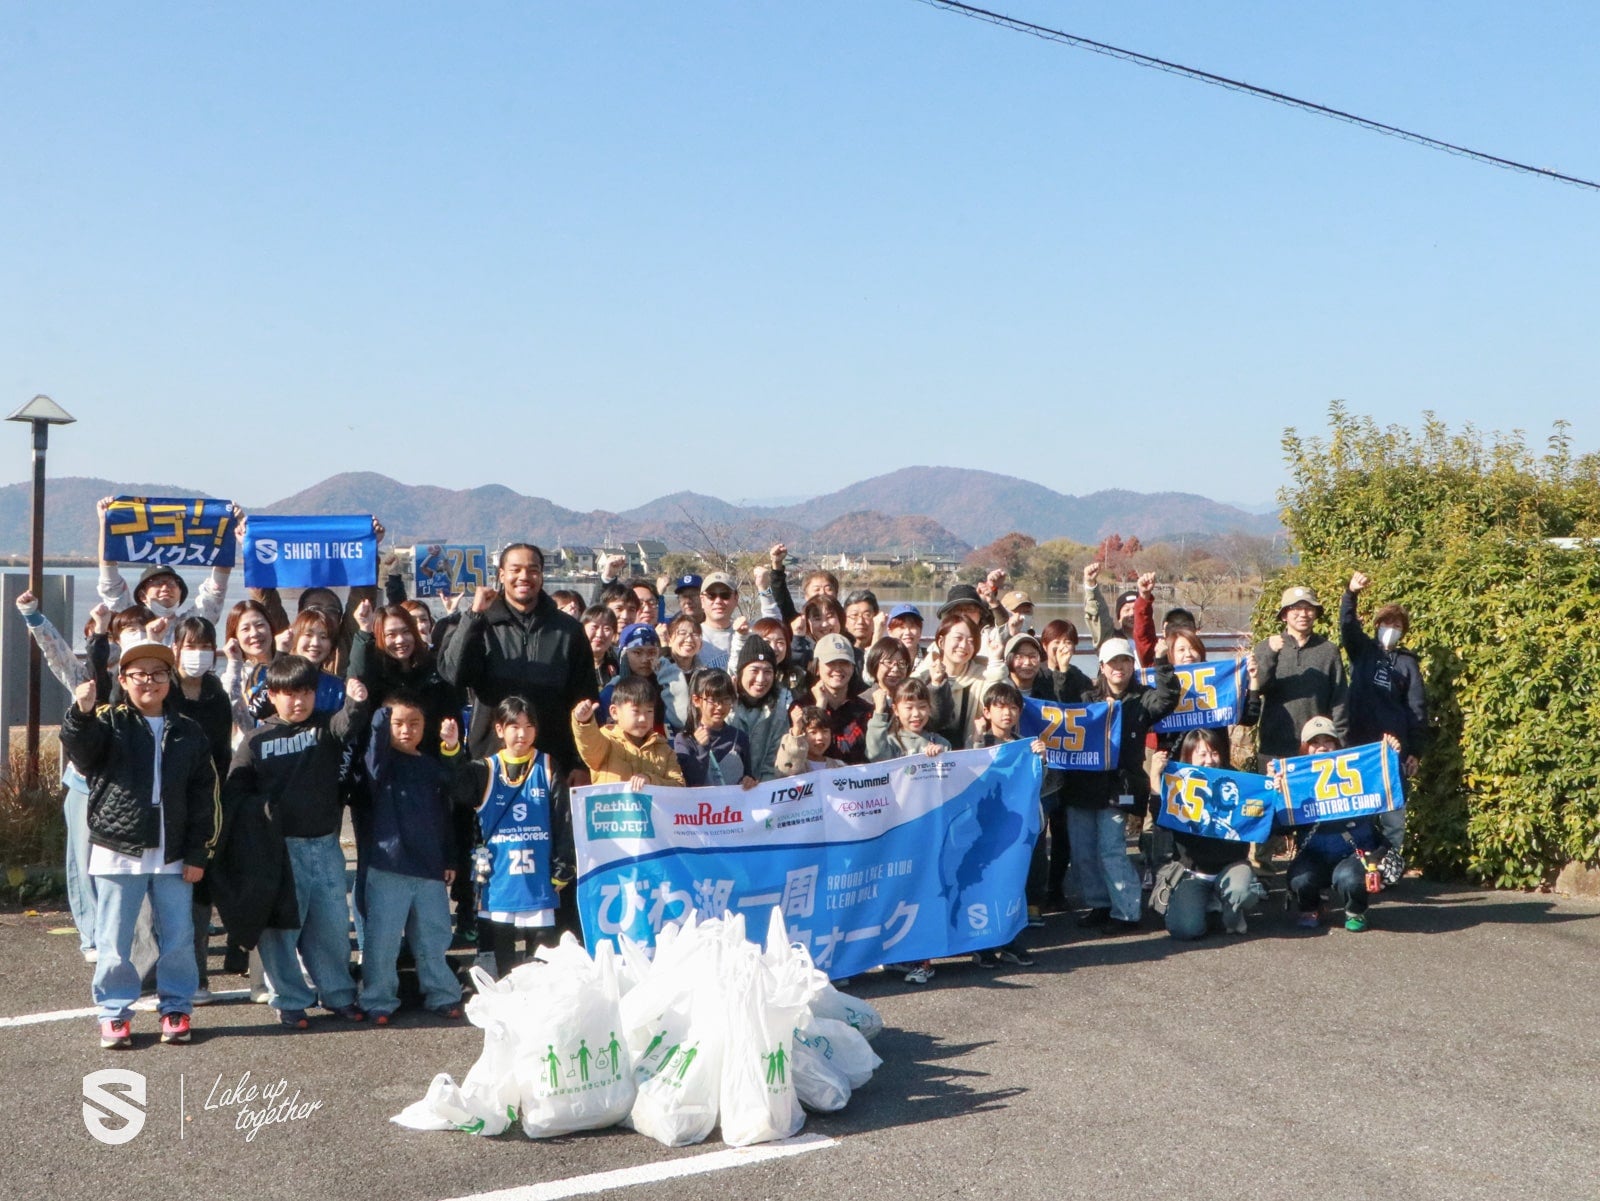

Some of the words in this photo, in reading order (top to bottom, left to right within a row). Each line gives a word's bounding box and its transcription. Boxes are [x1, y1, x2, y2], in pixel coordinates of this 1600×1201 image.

[284, 543, 321, 560] SHIGA
[325, 542, 363, 559] LAKES
[447, 549, 484, 594] 25
[1174, 667, 1218, 713] 25
[1040, 706, 1087, 751] 25
[1161, 711, 1204, 729] SHINTARO
[1070, 751, 1100, 766] EHARA
[849, 773, 890, 790] hummel
[1311, 752, 1364, 802] 25
[594, 800, 643, 812] Rethink
[866, 797, 890, 809] MALL
[1164, 773, 1209, 822] 25
[1303, 799, 1350, 818] SHINTARO
[1352, 793, 1382, 811] EHARA
[673, 802, 744, 826] muRata
[594, 822, 648, 832] PROJECT
[508, 849, 536, 876] 25
[887, 859, 913, 878] BIWA
